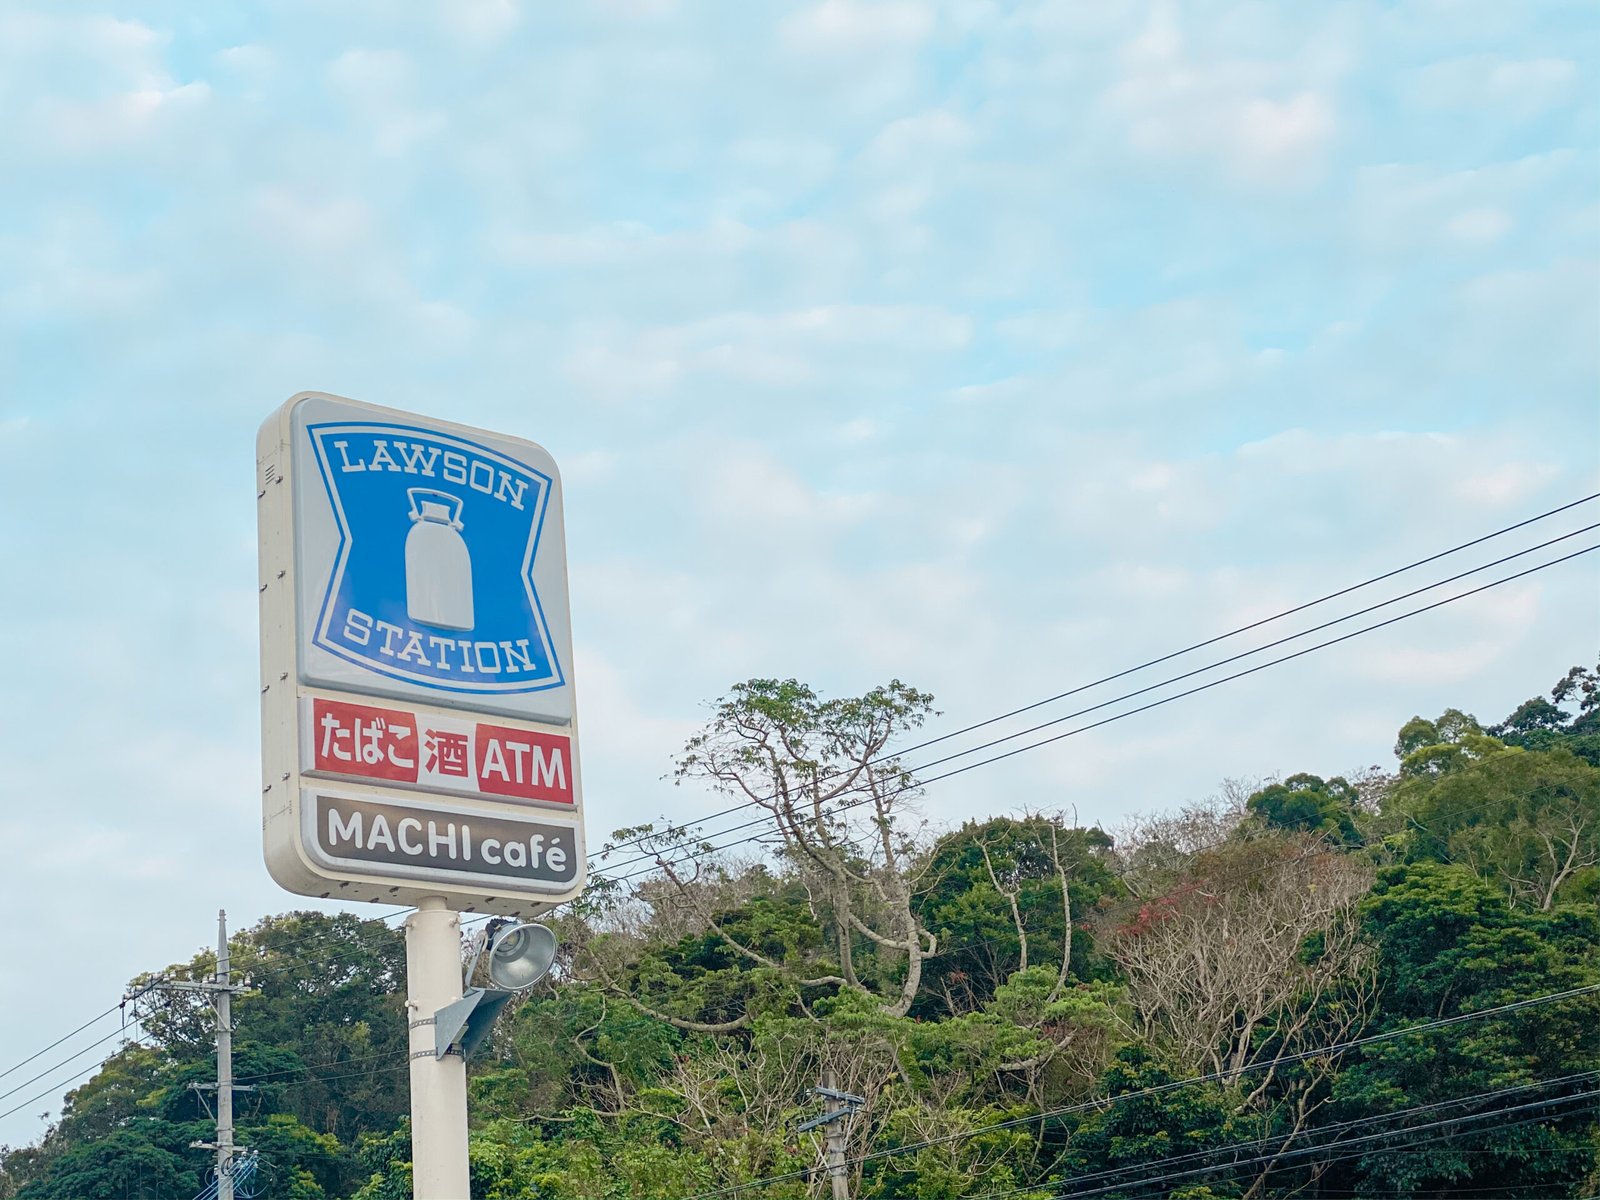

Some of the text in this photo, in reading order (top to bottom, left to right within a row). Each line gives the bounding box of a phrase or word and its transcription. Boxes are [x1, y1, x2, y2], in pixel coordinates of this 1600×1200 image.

[335, 440, 529, 511] LAWSON
[343, 608, 537, 673] STATION
[321, 713, 414, 768] たばこ
[424, 729, 469, 777] 酒
[481, 738, 567, 790] ATM
[328, 808, 567, 872] MACHI café
